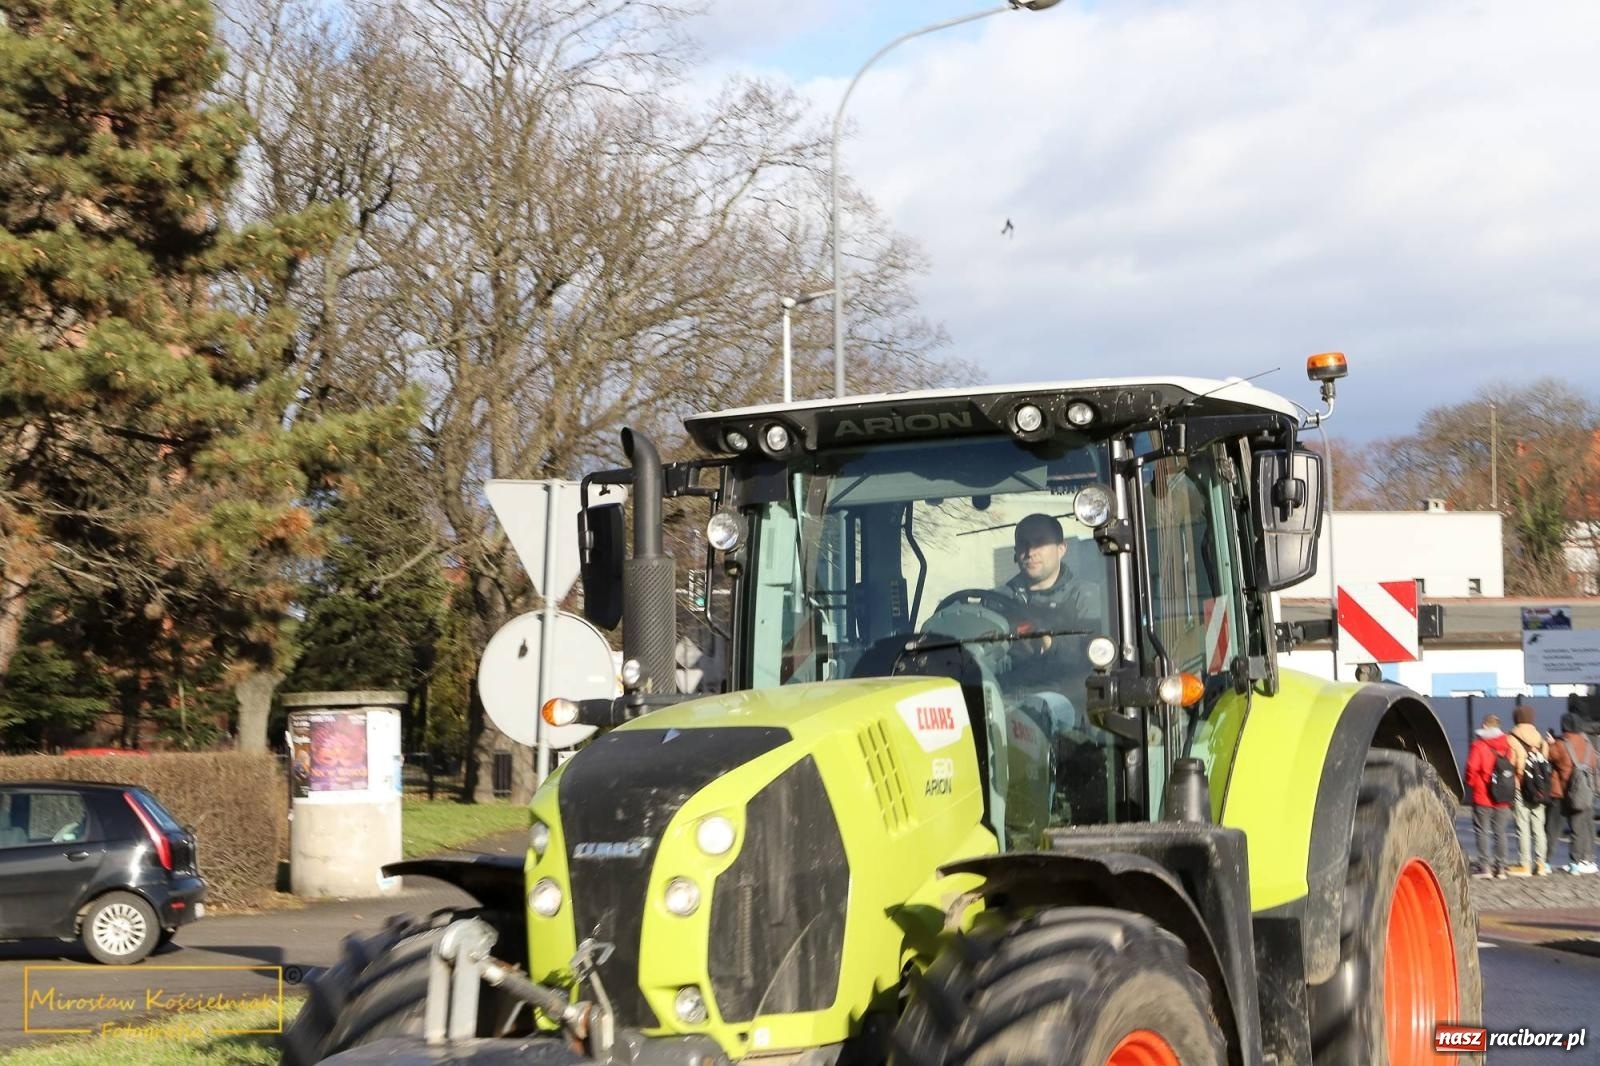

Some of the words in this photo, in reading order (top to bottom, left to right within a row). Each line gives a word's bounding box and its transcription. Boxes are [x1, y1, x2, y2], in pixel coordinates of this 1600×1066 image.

[833, 411, 974, 437] ARION
[916, 707, 955, 730] CLAAS
[924, 778, 952, 796] ARION
